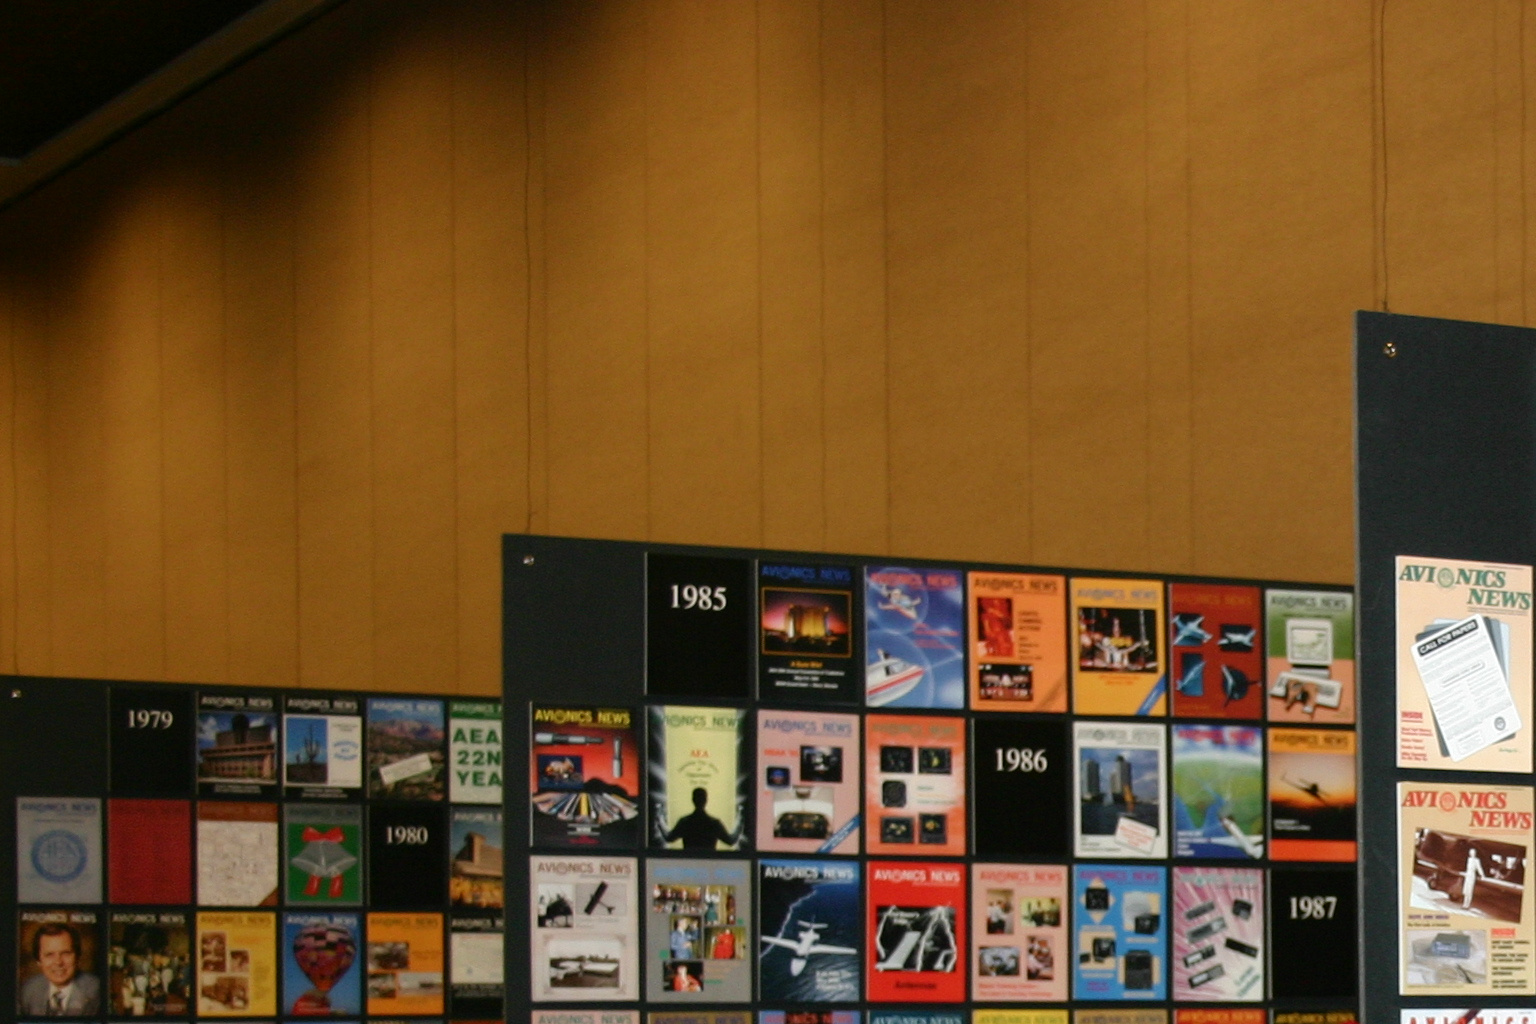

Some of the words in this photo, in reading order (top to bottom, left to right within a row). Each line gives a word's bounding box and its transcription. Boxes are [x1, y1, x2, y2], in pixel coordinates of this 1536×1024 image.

[1399, 564, 1506, 588] AVIONICS
[671, 584, 727, 611] 1985
[1467, 588, 1531, 611] NEWS
[1419, 639, 1438, 655] CALL
[1437, 631, 1451, 647] FOR
[1450, 619, 1477, 639] PAPERS
[128, 709, 173, 729] 1979
[535, 709, 592, 724] AVIONICS
[597, 711, 630, 725] NEWS
[453, 728, 500, 743] AEA
[763, 719, 816, 735] AVIONICS
[822, 722, 852, 734] NEWS
[995, 748, 1048, 773] 1986
[1402, 791, 1507, 812] AVIONICS
[1469, 811, 1532, 830] NEWS
[386, 826, 428, 844] 1980
[537, 862, 594, 875] AVIONICS
[600, 863, 631, 874] NEWS
[765, 867, 818, 881] AVIONICS
[823, 868, 854, 880] NEWS
[875, 869, 926, 883] AVIONICS
[931, 871, 961, 882] NEWS
[1290, 896, 1338, 920] 1987
